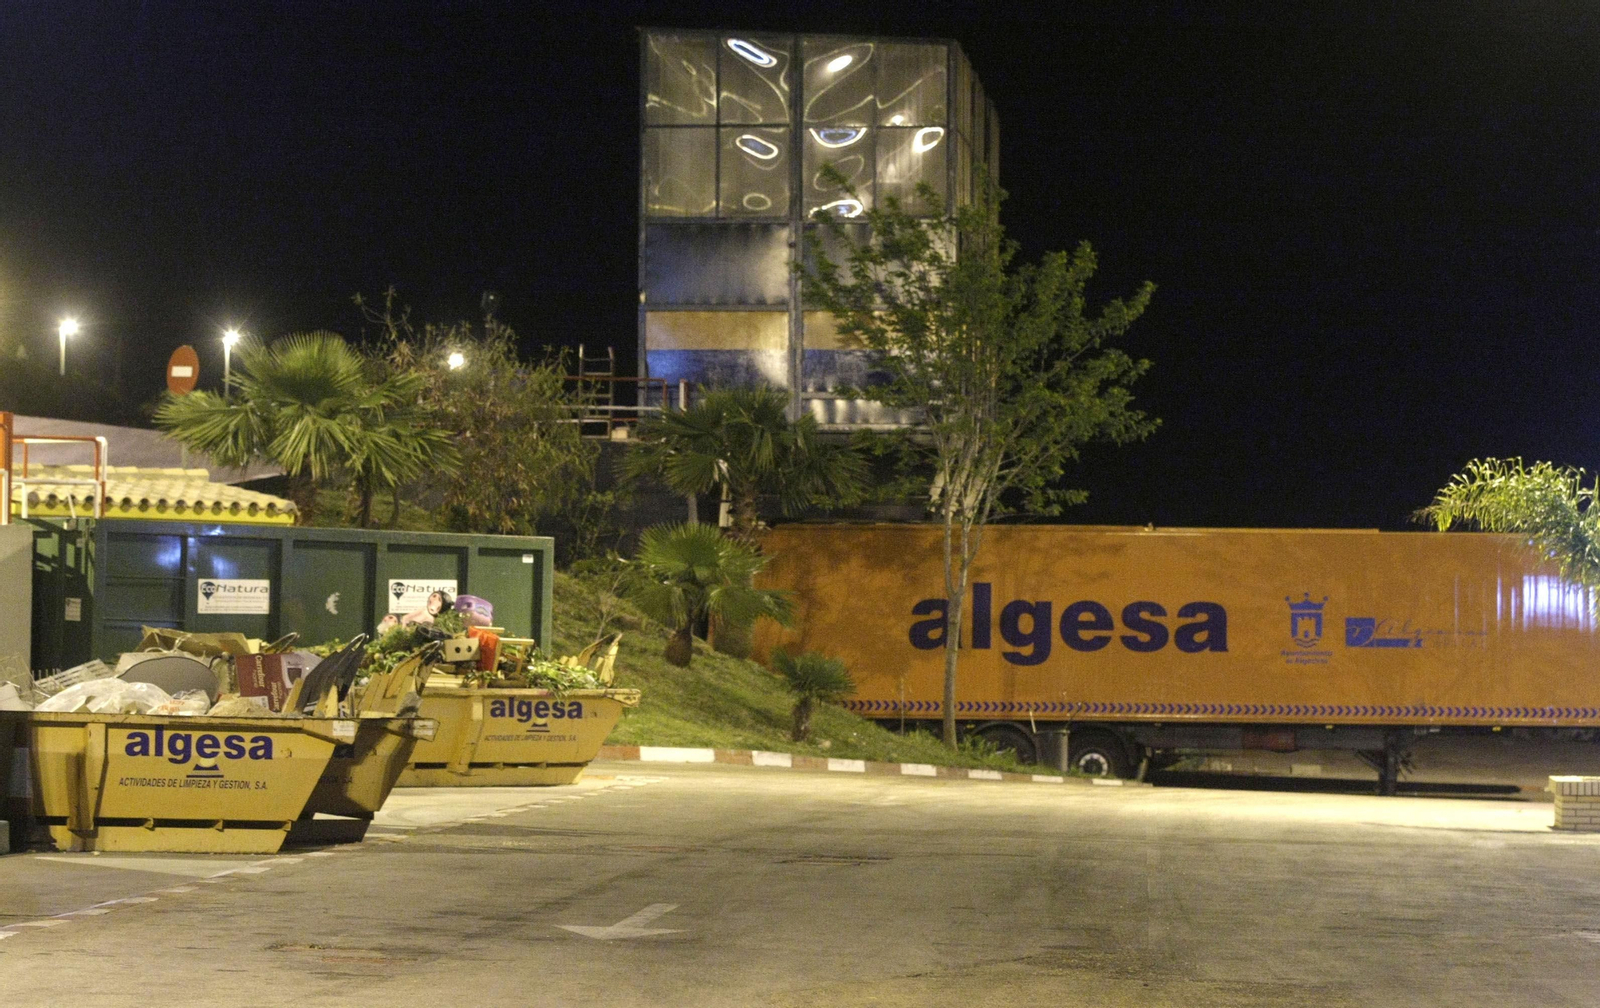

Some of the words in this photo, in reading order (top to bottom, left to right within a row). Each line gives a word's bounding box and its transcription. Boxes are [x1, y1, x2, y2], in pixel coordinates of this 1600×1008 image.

[909, 583, 1229, 666] algesa
[490, 696, 583, 723] algesa
[125, 724, 273, 764] algesa
[119, 777, 166, 787] ACTIVIDADES
[168, 778, 177, 788] DE
[179, 779, 212, 788] LIMPIEZA
[213, 780, 218, 789] Y
